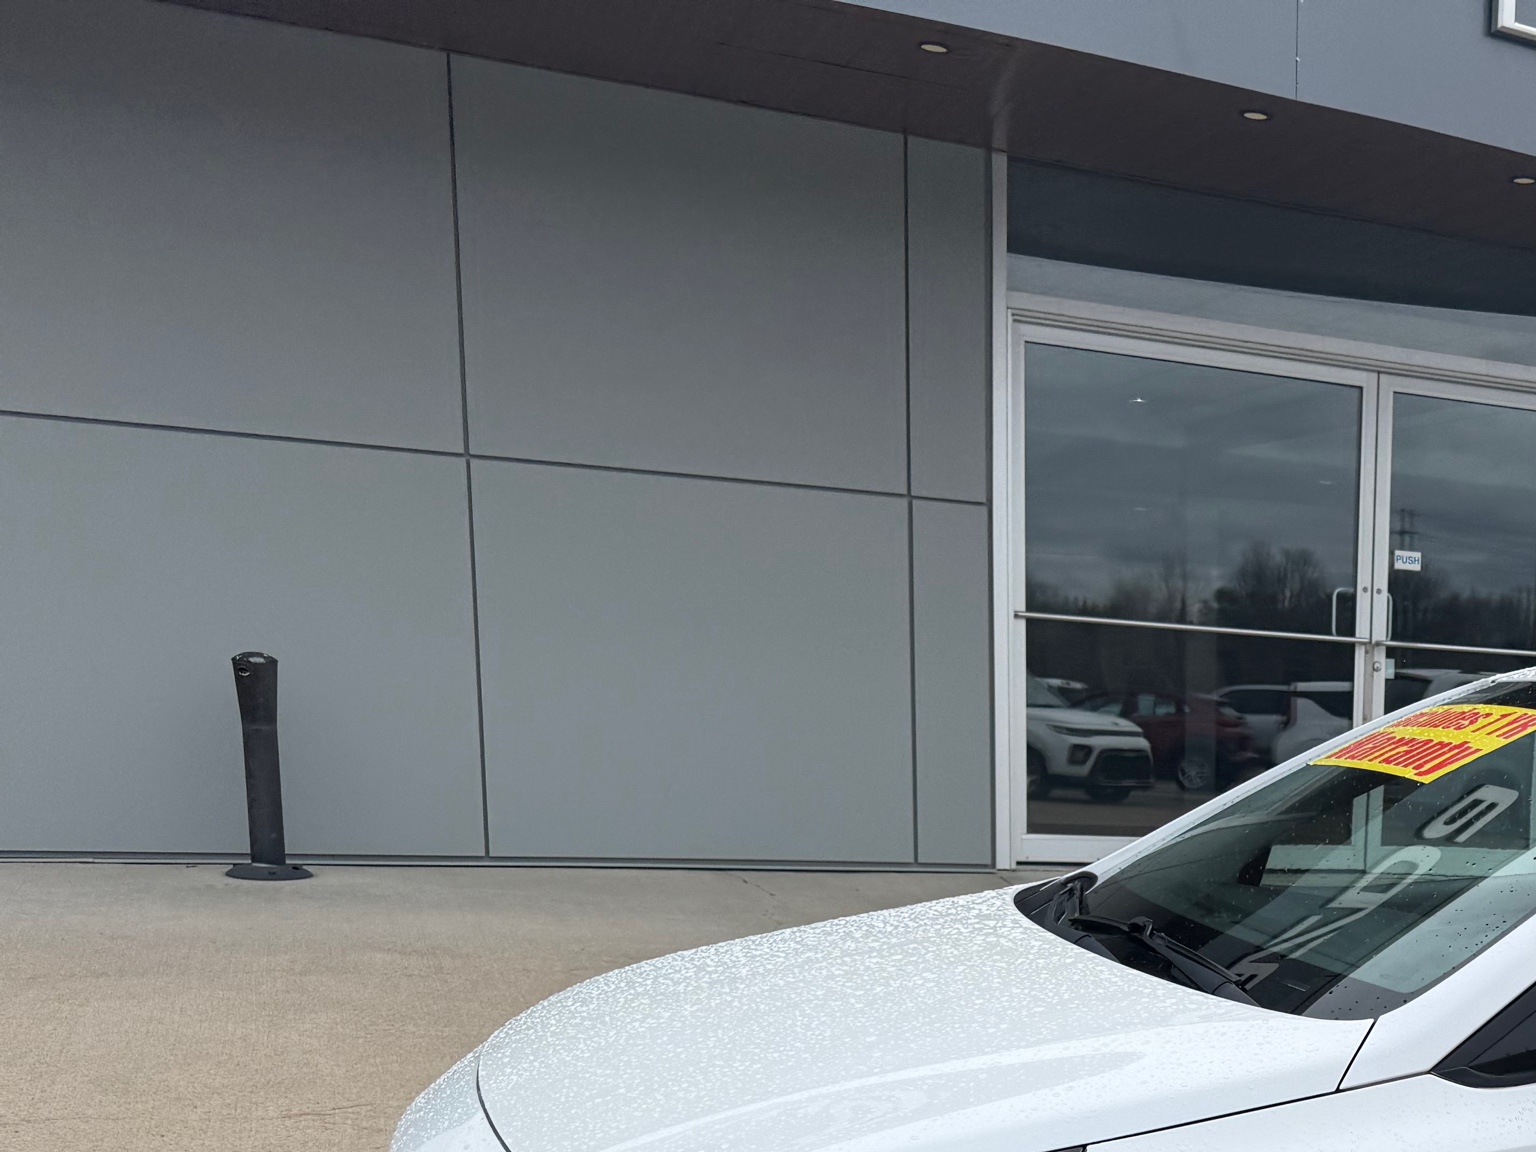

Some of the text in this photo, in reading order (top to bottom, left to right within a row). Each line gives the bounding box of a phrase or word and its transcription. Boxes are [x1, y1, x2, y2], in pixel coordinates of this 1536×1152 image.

[1395, 554, 1420, 565] PUSH
[1471, 711, 1518, 734] 1
[1328, 732, 1483, 777] Warranty
